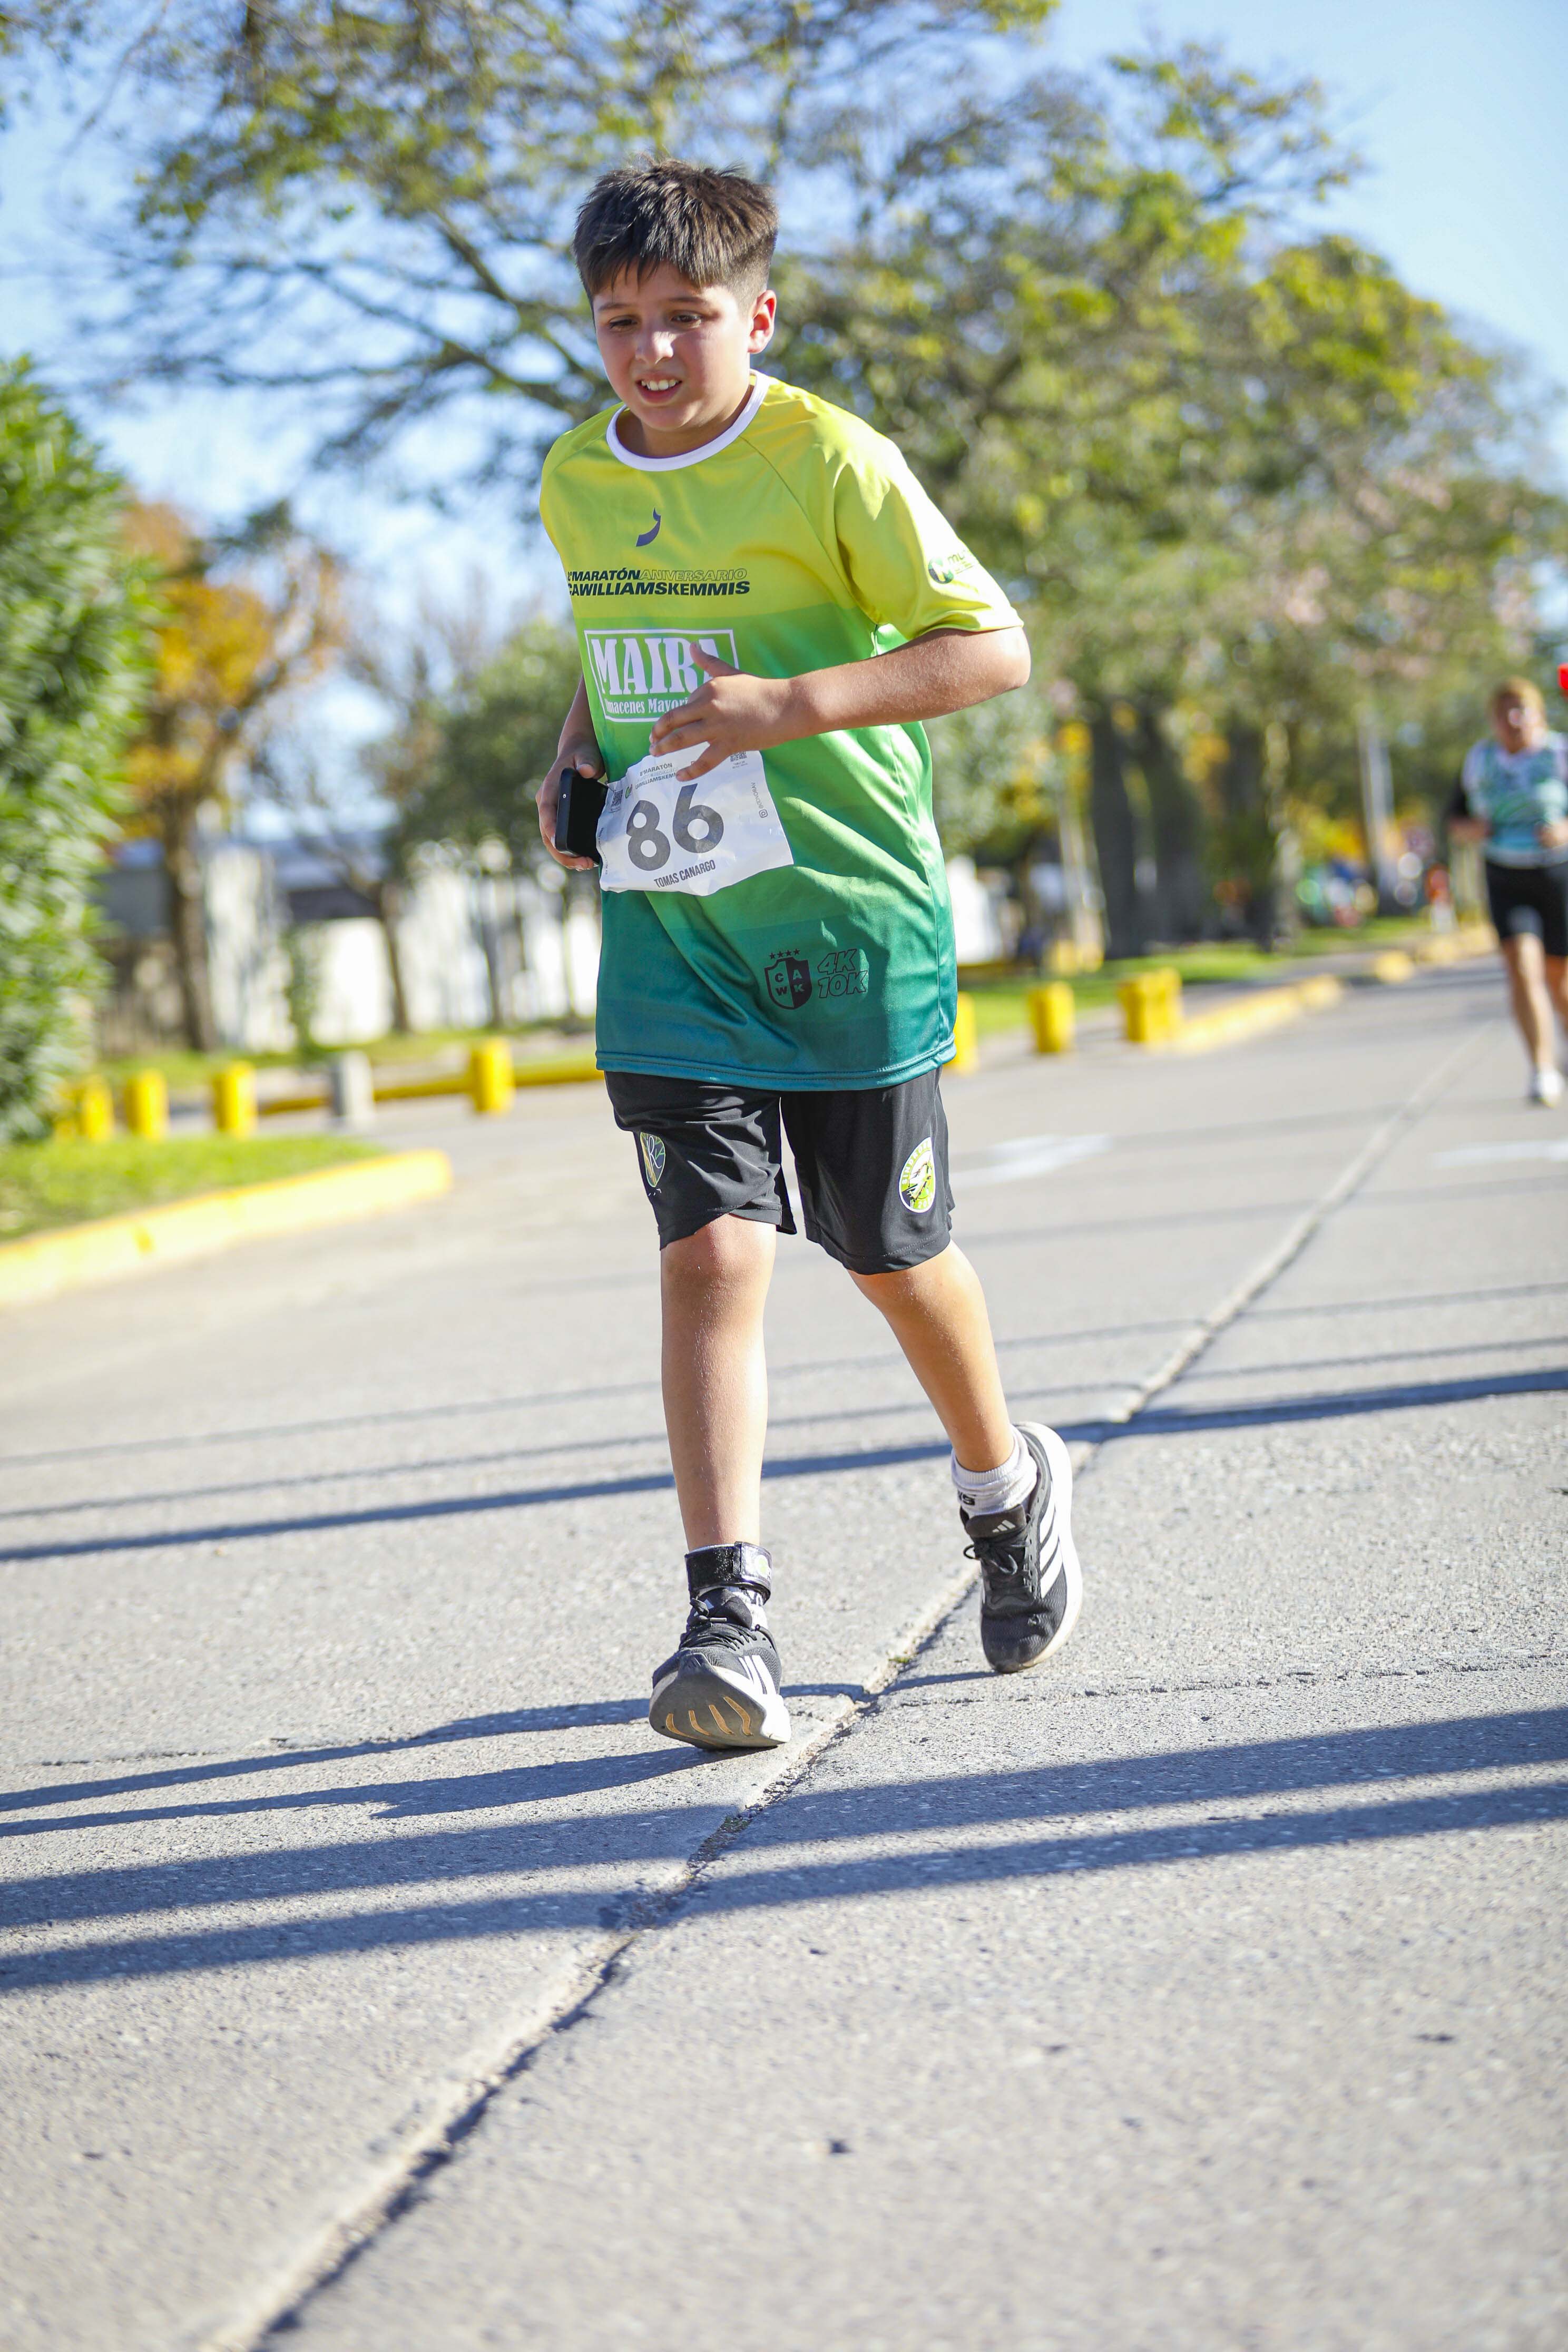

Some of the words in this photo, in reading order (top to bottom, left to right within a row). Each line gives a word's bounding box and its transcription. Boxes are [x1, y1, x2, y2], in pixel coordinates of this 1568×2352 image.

[626, 783, 724, 871] 86
[654, 875, 679, 888] TOMAS
[679, 859, 716, 881] CANARGO
[817, 949, 857, 975] 4K
[818, 970, 868, 998] 10K
